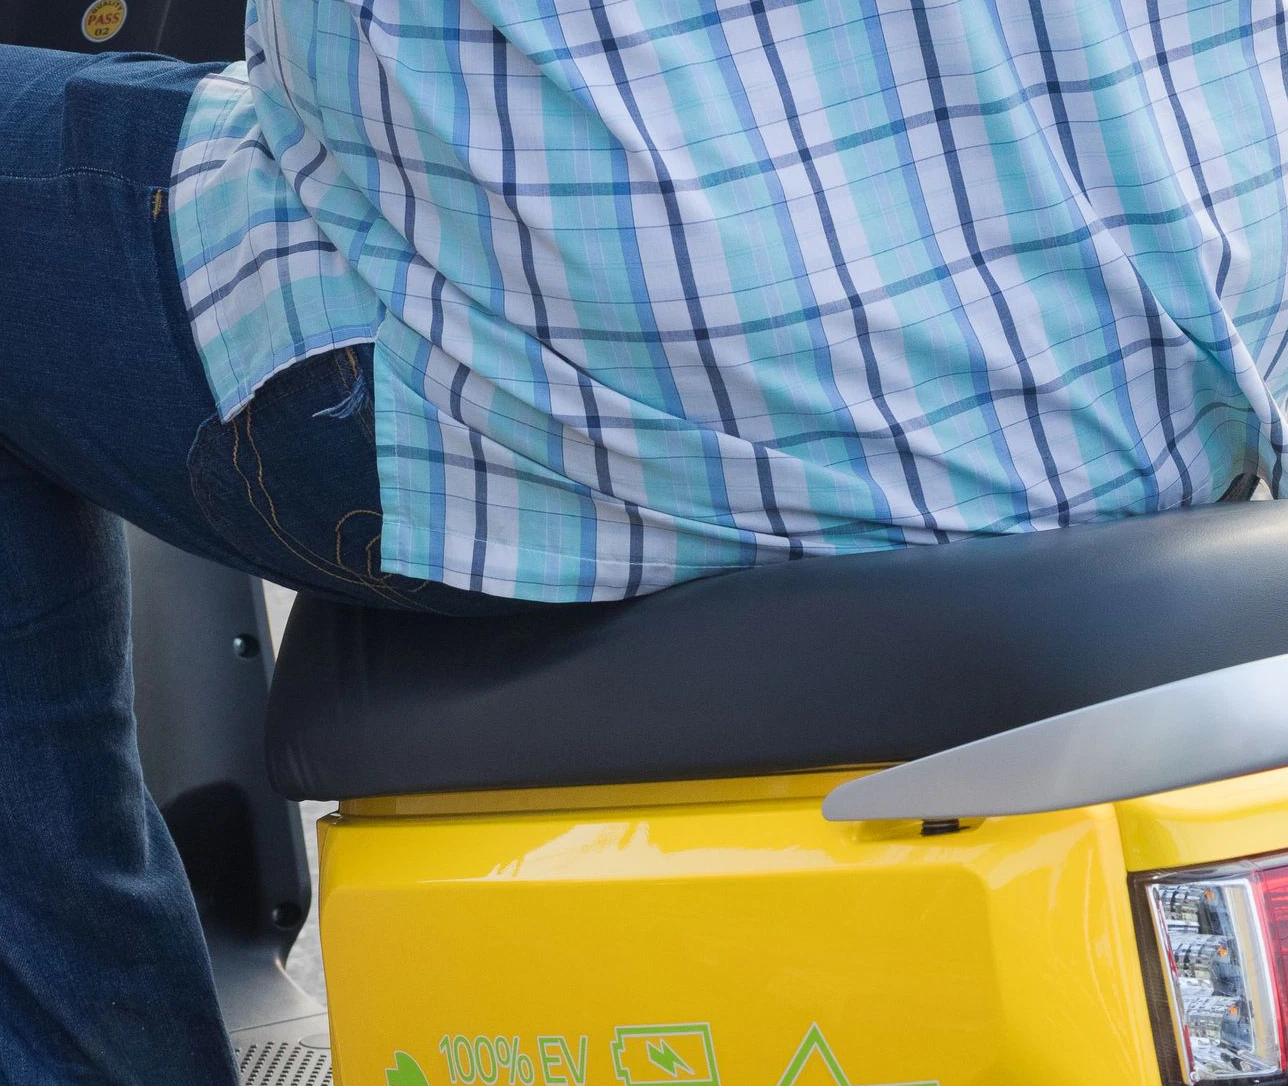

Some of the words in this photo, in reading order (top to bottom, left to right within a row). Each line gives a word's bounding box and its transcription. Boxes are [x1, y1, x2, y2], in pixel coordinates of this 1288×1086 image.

[88, 13, 120, 25] PASS
[94, 27, 109, 36] 02
[438, 1033, 535, 1086] 100%
[537, 1034, 588, 1086] EV
